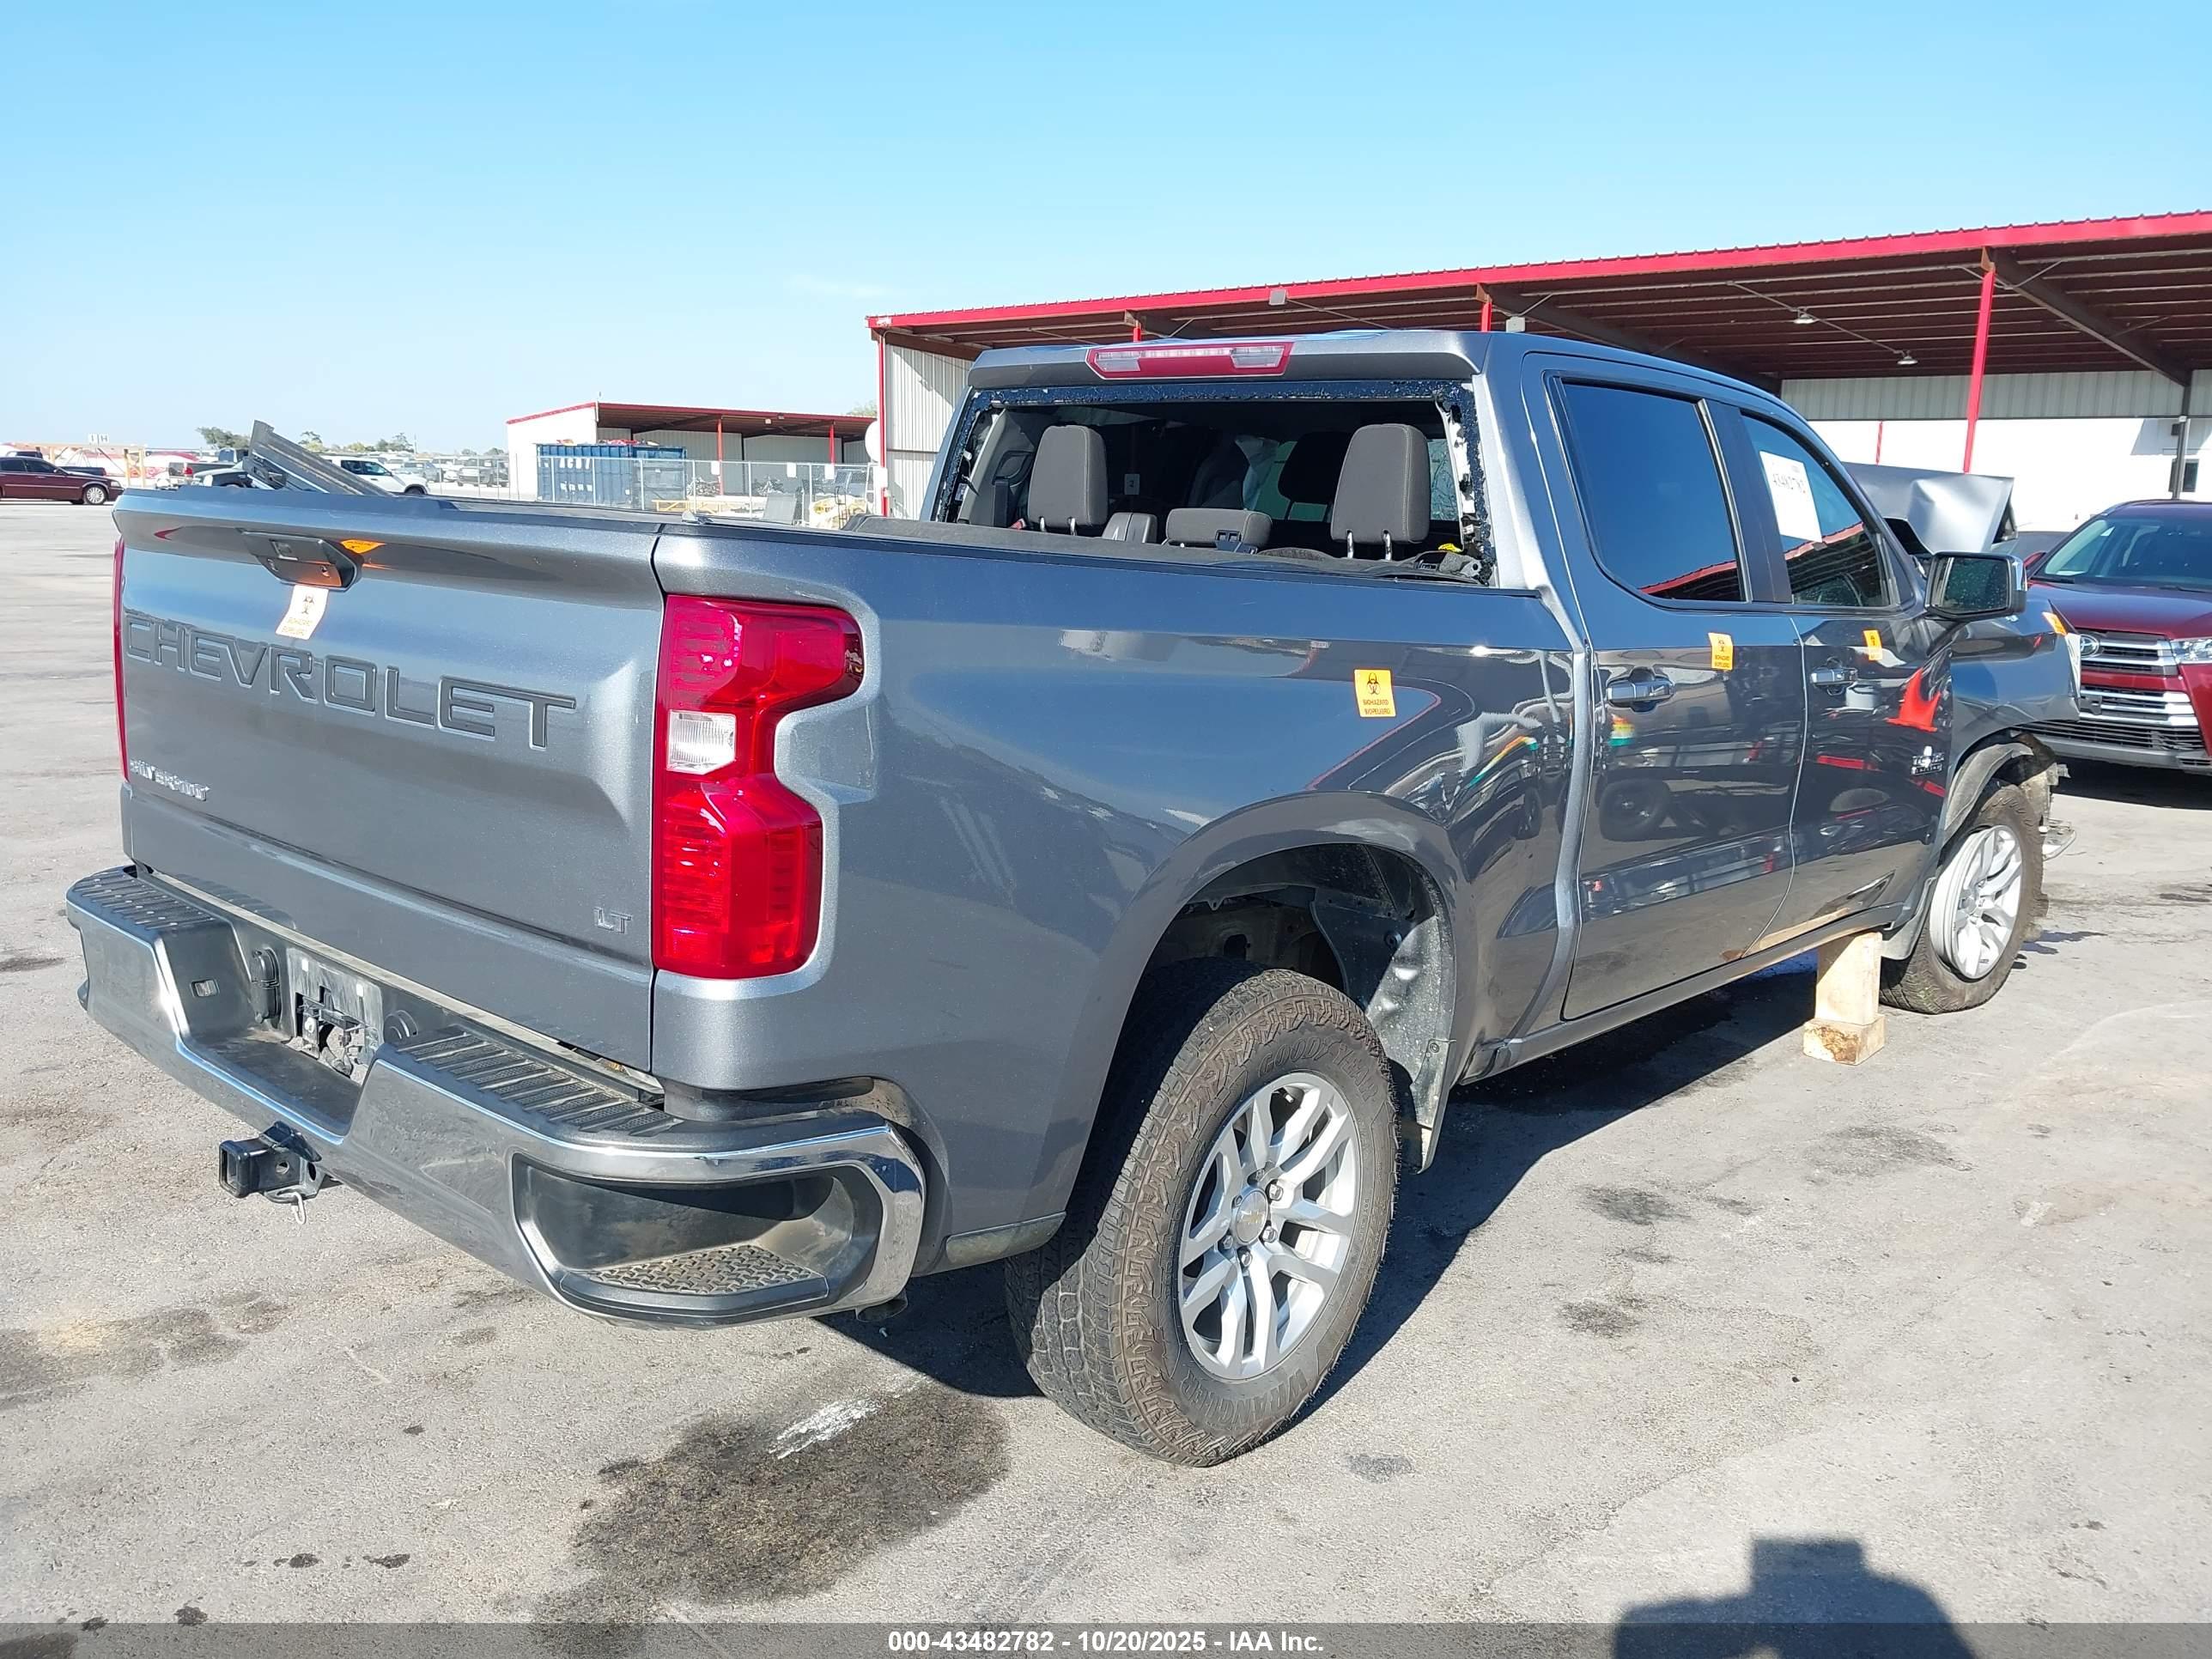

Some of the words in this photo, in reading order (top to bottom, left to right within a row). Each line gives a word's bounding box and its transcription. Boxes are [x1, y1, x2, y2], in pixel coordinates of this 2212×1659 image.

[125, 608, 577, 750] CHEVROLET
[593, 906, 633, 934] LT
[1258, 1036, 1379, 1103] GOODYEAR
[1180, 1369, 1309, 1423] WRANGLER
